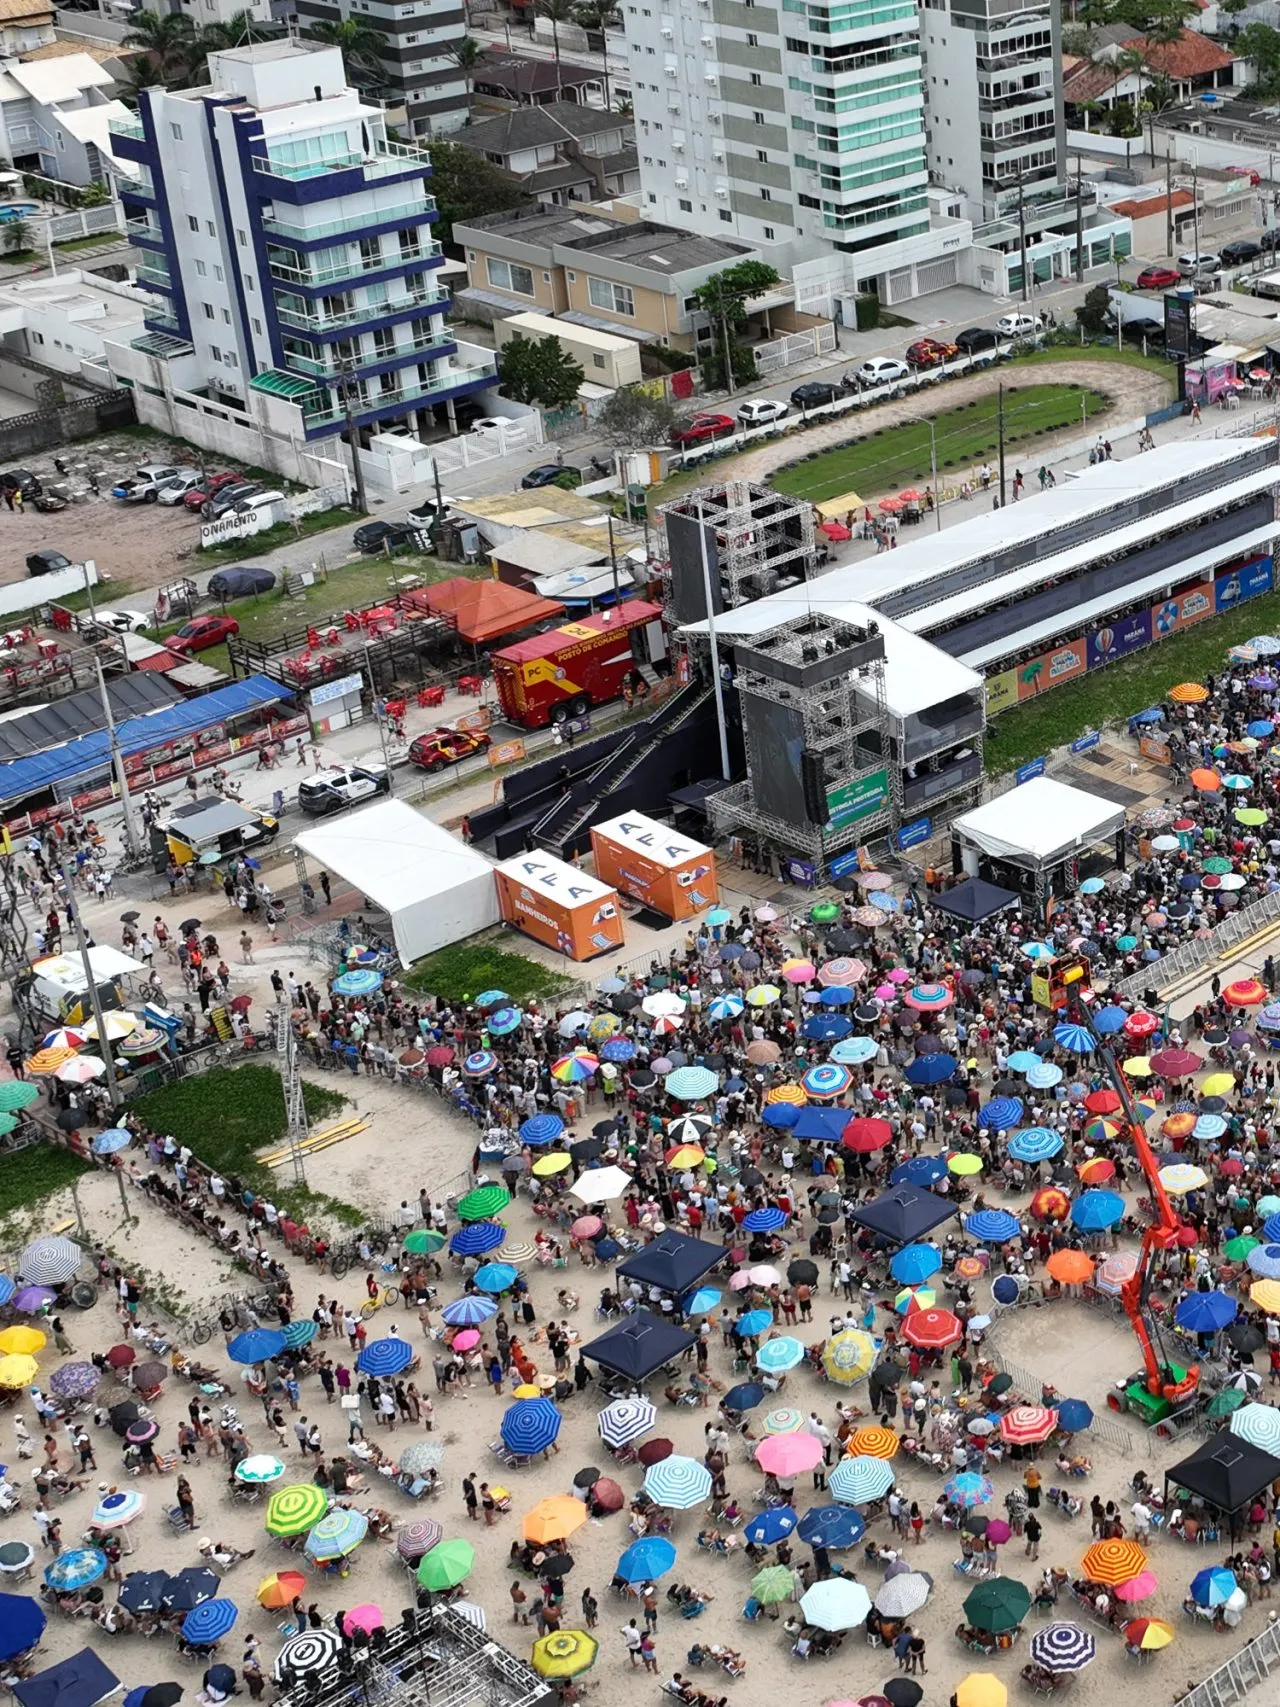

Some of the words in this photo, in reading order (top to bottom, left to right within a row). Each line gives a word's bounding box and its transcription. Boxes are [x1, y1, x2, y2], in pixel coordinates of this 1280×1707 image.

[558, 649, 582, 662] POSTO
[582, 643, 592, 653] DE
[593, 630, 629, 648] COMANDO
[528, 666, 542, 678] PC
